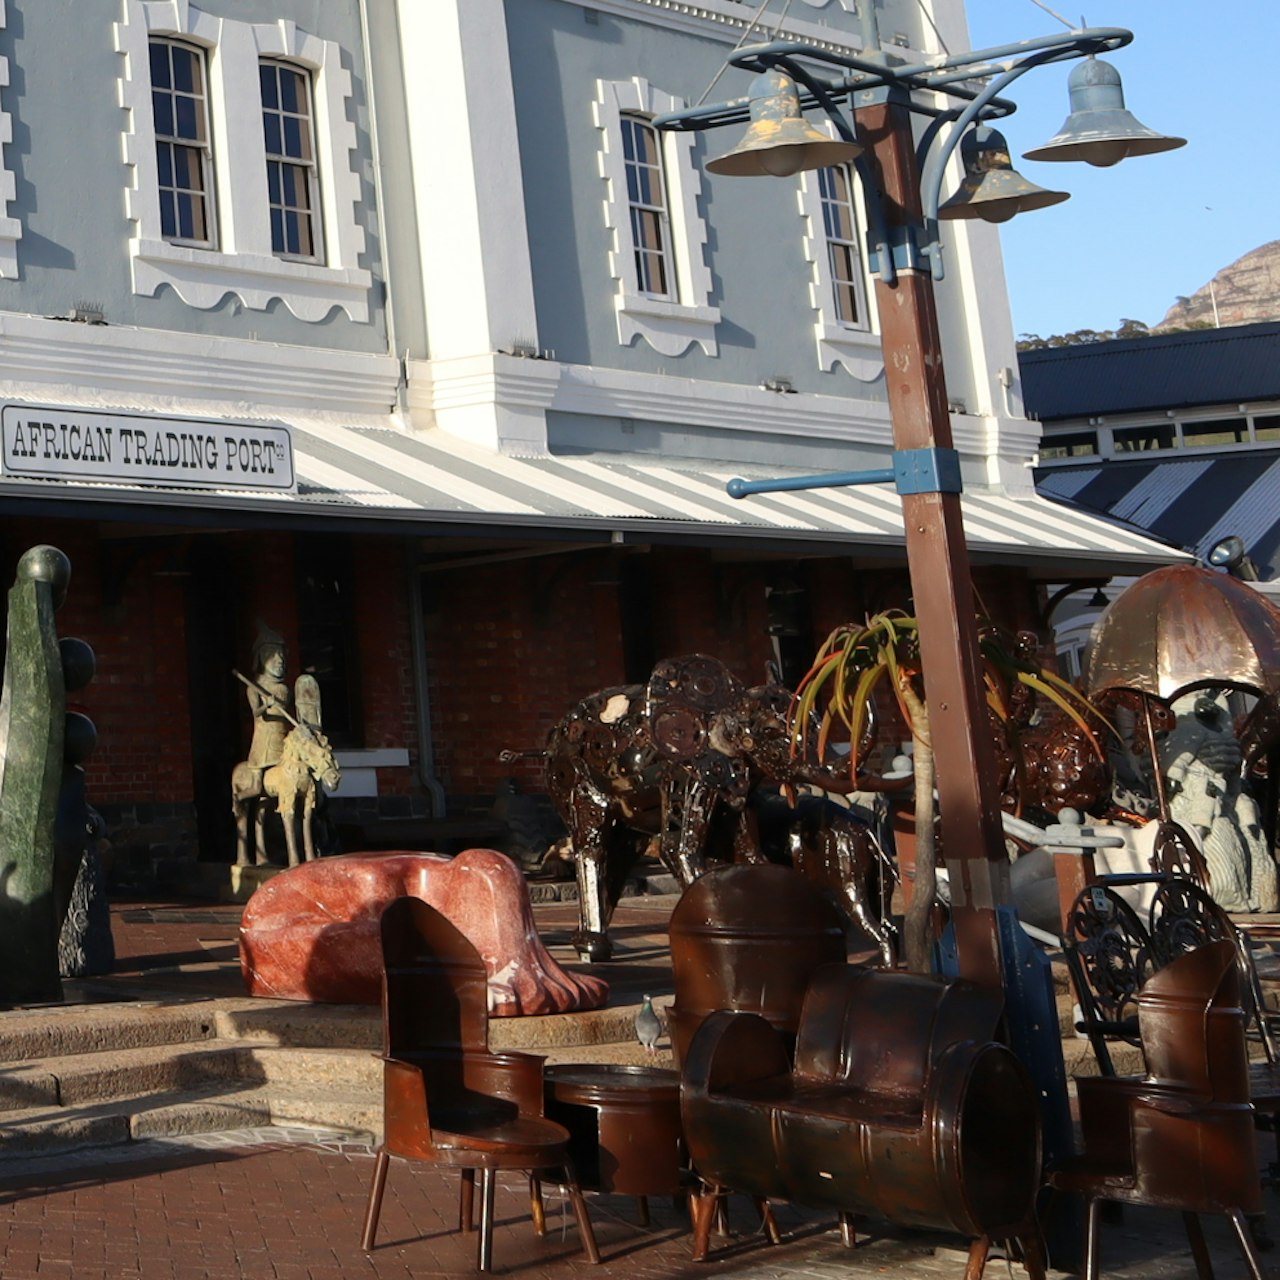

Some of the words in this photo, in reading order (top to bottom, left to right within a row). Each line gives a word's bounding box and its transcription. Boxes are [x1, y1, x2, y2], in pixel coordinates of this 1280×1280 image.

[12, 421, 112, 462] AFRICAN
[120, 429, 218, 470] TRADING
[224, 437, 275, 474] PORT
